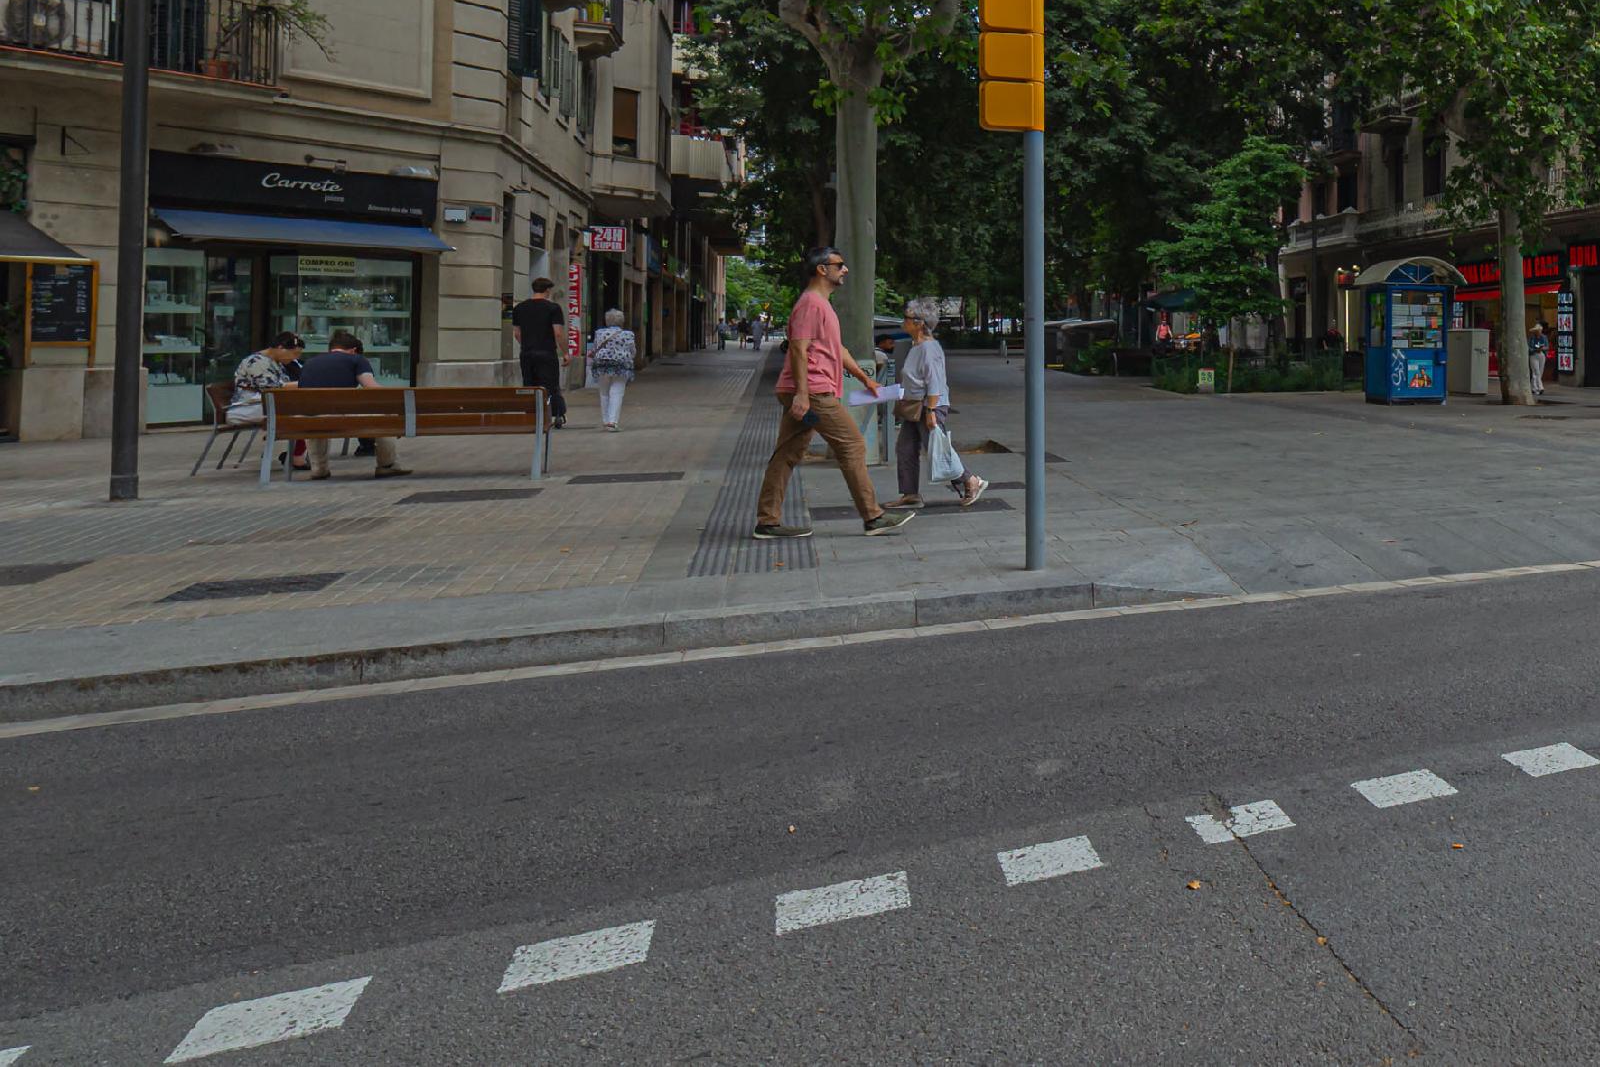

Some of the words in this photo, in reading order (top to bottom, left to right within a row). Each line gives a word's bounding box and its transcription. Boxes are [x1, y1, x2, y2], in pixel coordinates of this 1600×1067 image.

[261, 172, 344, 192] Carrete
[593, 228, 623, 242] 24H
[594, 241, 622, 250] SUPER
[299, 258, 336, 266] COMPRO
